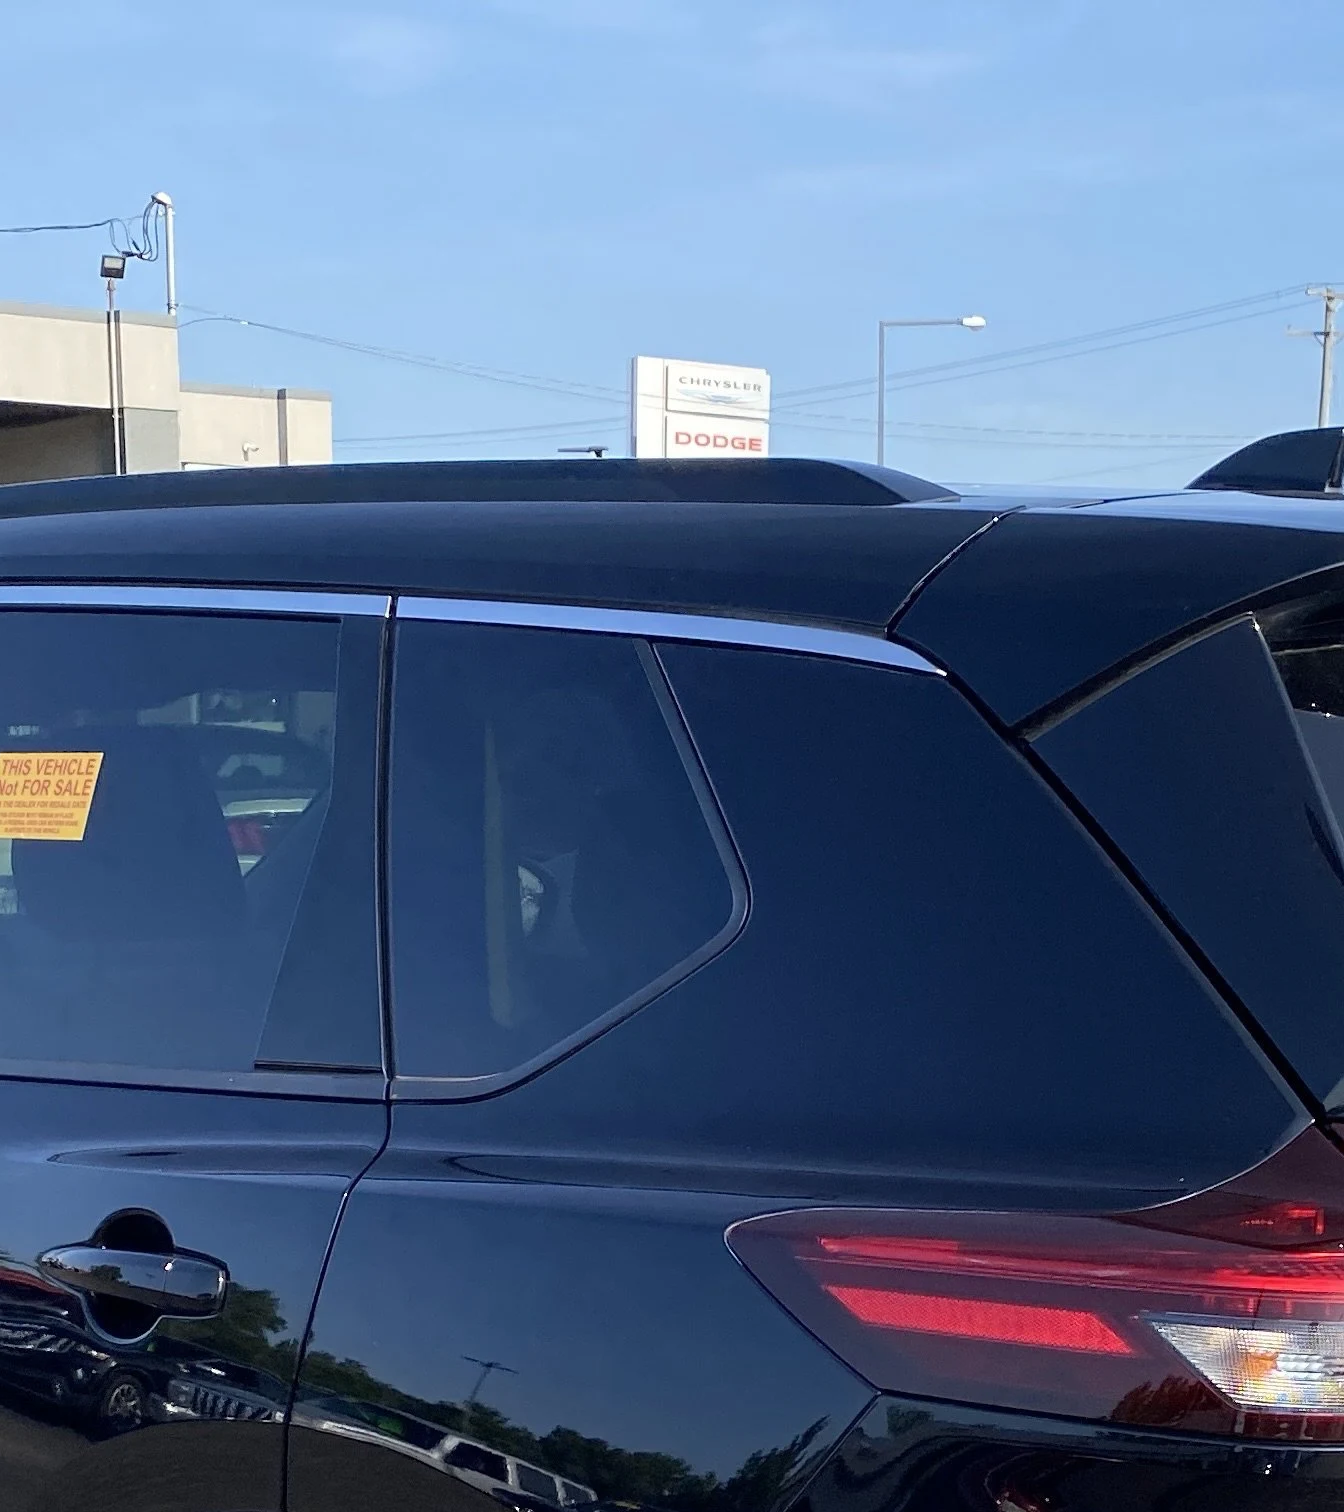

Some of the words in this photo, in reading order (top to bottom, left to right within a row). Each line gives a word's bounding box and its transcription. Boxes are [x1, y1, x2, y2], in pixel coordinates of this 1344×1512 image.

[678, 376, 763, 392] CHRYSLER
[675, 431, 763, 452] DODGE
[1, 759, 32, 776] THIS
[36, 758, 96, 776] VEHICLE
[21, 780, 51, 796] FOR
[54, 780, 94, 796] SALE
